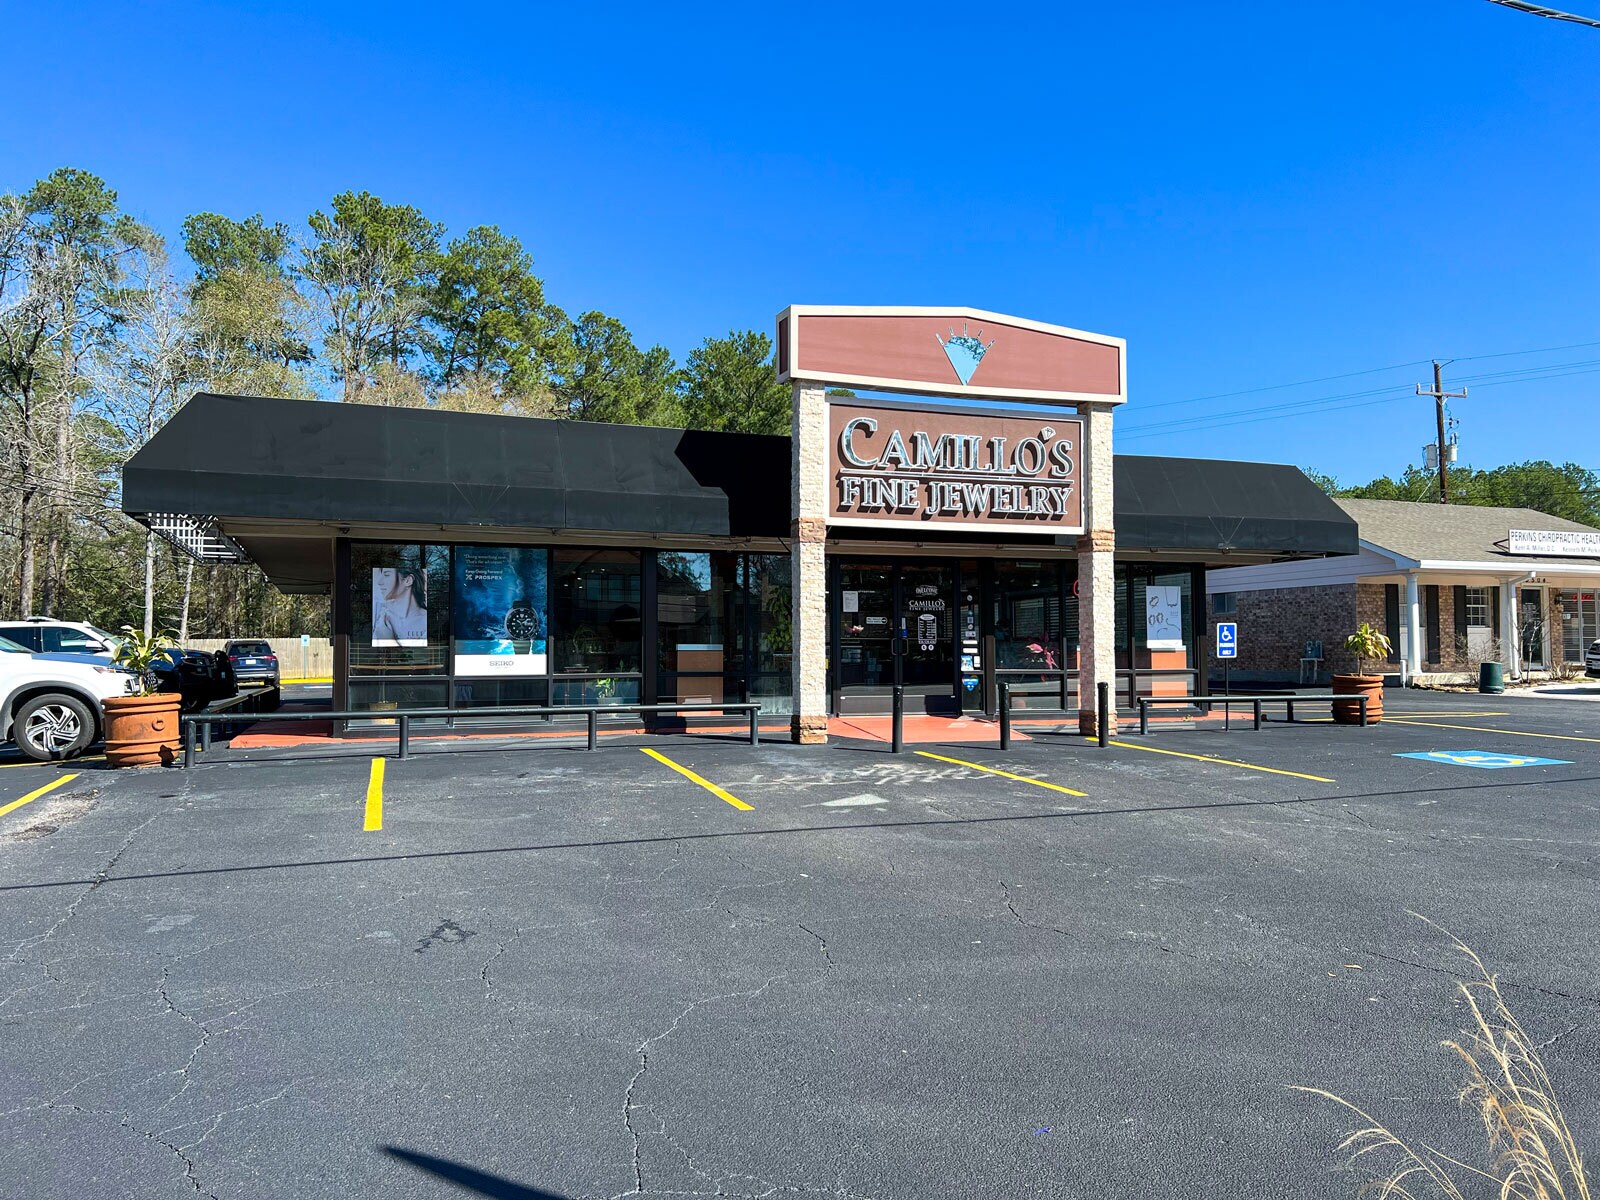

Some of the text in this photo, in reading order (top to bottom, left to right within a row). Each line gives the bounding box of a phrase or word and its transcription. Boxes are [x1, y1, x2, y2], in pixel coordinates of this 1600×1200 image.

[841, 417, 1074, 477] CAMILLO'S
[840, 477, 1072, 515] FINE JEWELRY
[1511, 531, 1600, 545] PERKINS CHIROPRACTIC HEALT
